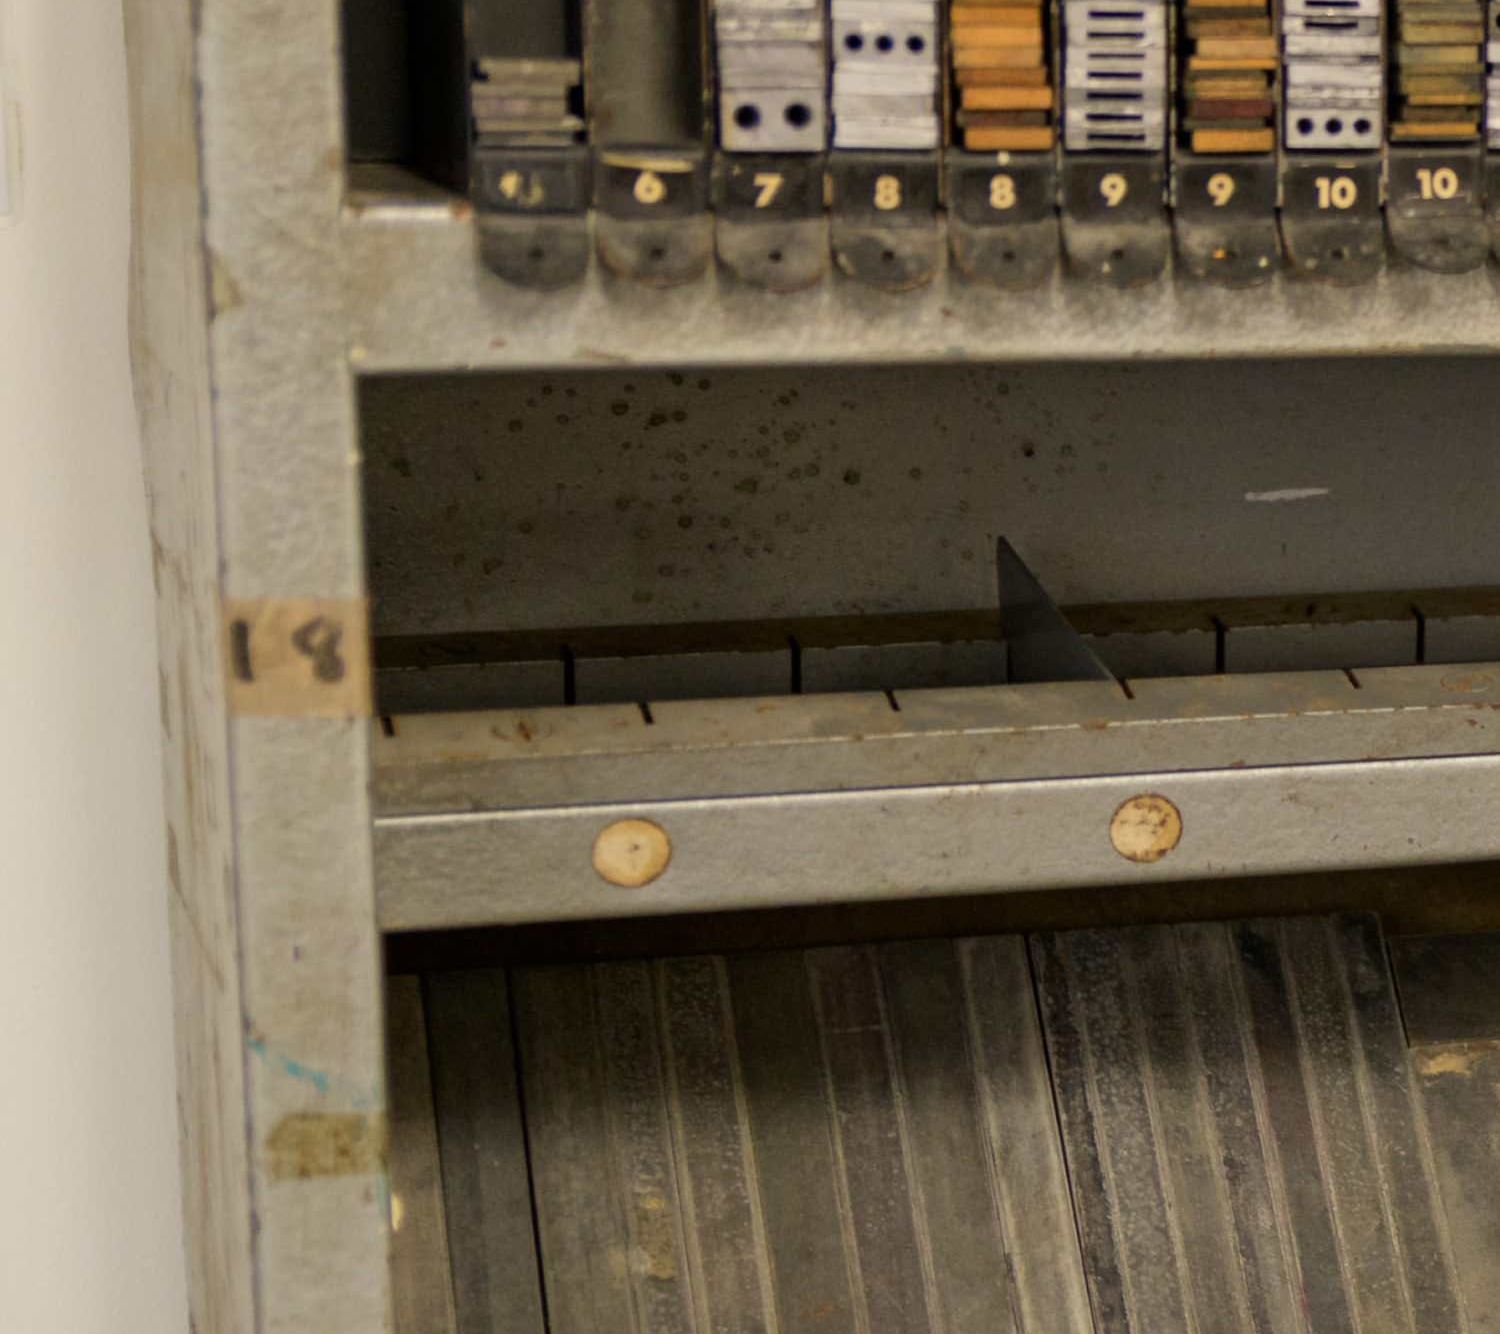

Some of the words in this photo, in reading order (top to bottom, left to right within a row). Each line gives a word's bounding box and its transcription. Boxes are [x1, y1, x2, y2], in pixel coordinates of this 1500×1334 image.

[633, 170, 665, 204] 6
[753, 173, 783, 208] 7
[874, 176, 901, 209] 8
[989, 173, 1017, 208] 8
[1100, 172, 1127, 207] 9
[1207, 172, 1236, 207] 9
[1315, 176, 1357, 209] 10
[1416, 167, 1459, 200] 10
